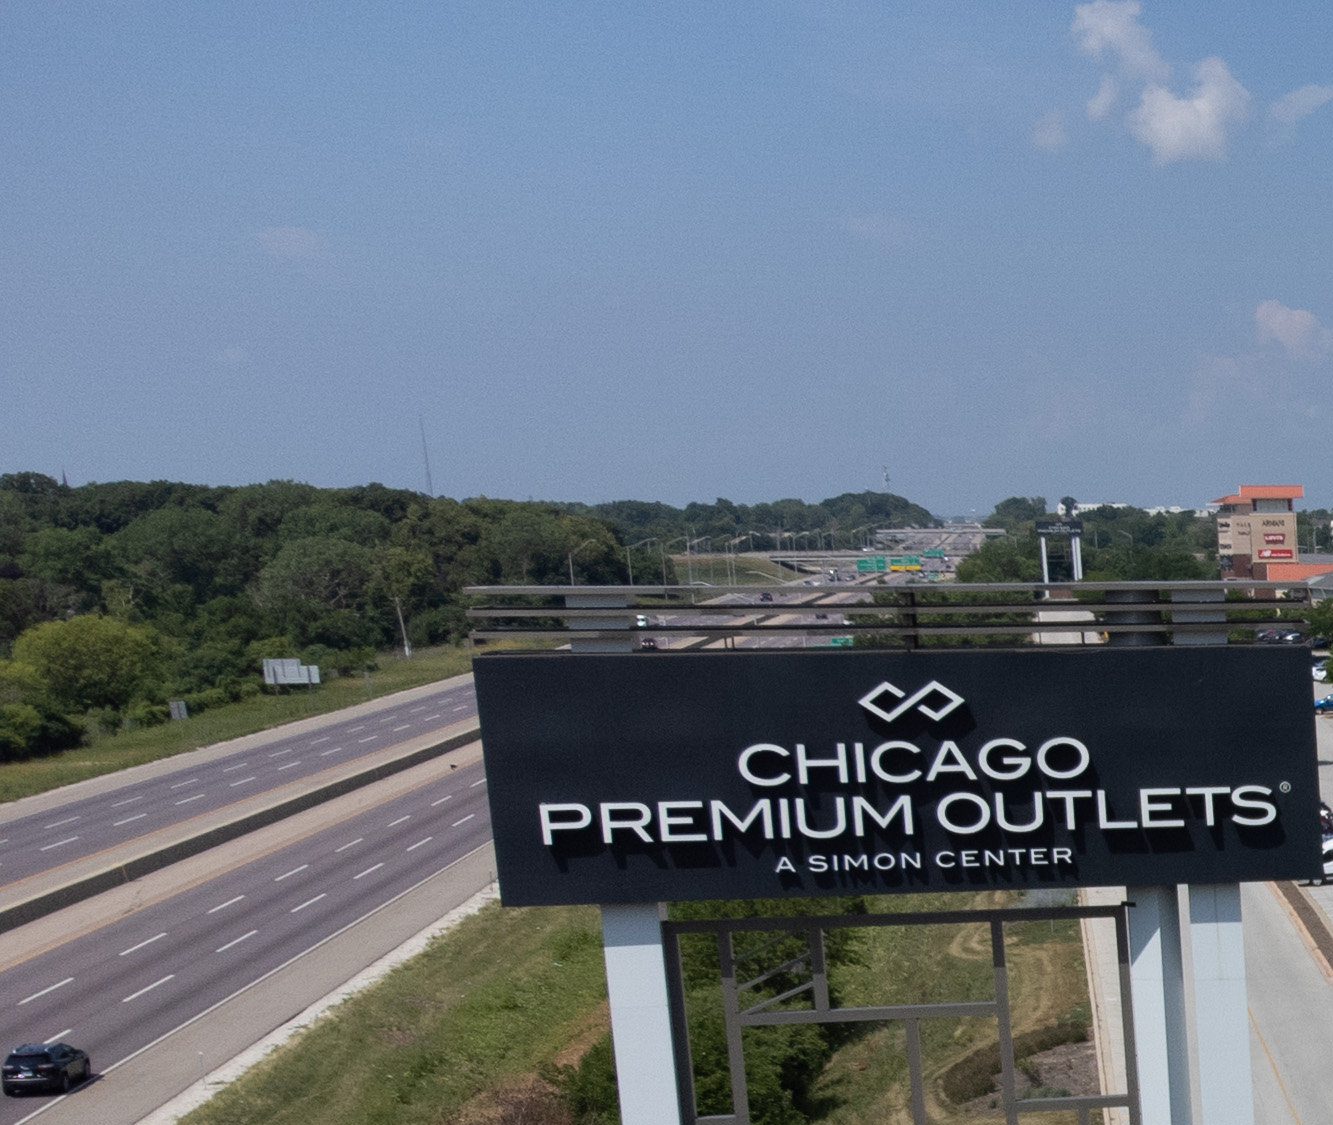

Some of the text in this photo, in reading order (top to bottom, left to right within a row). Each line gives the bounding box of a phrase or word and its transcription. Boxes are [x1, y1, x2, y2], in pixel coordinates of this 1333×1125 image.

[738, 736, 1090, 787] CHICAGO
[539, 795, 914, 846] PREMIUM
[775, 848, 1072, 873] A SIMON CENTER
